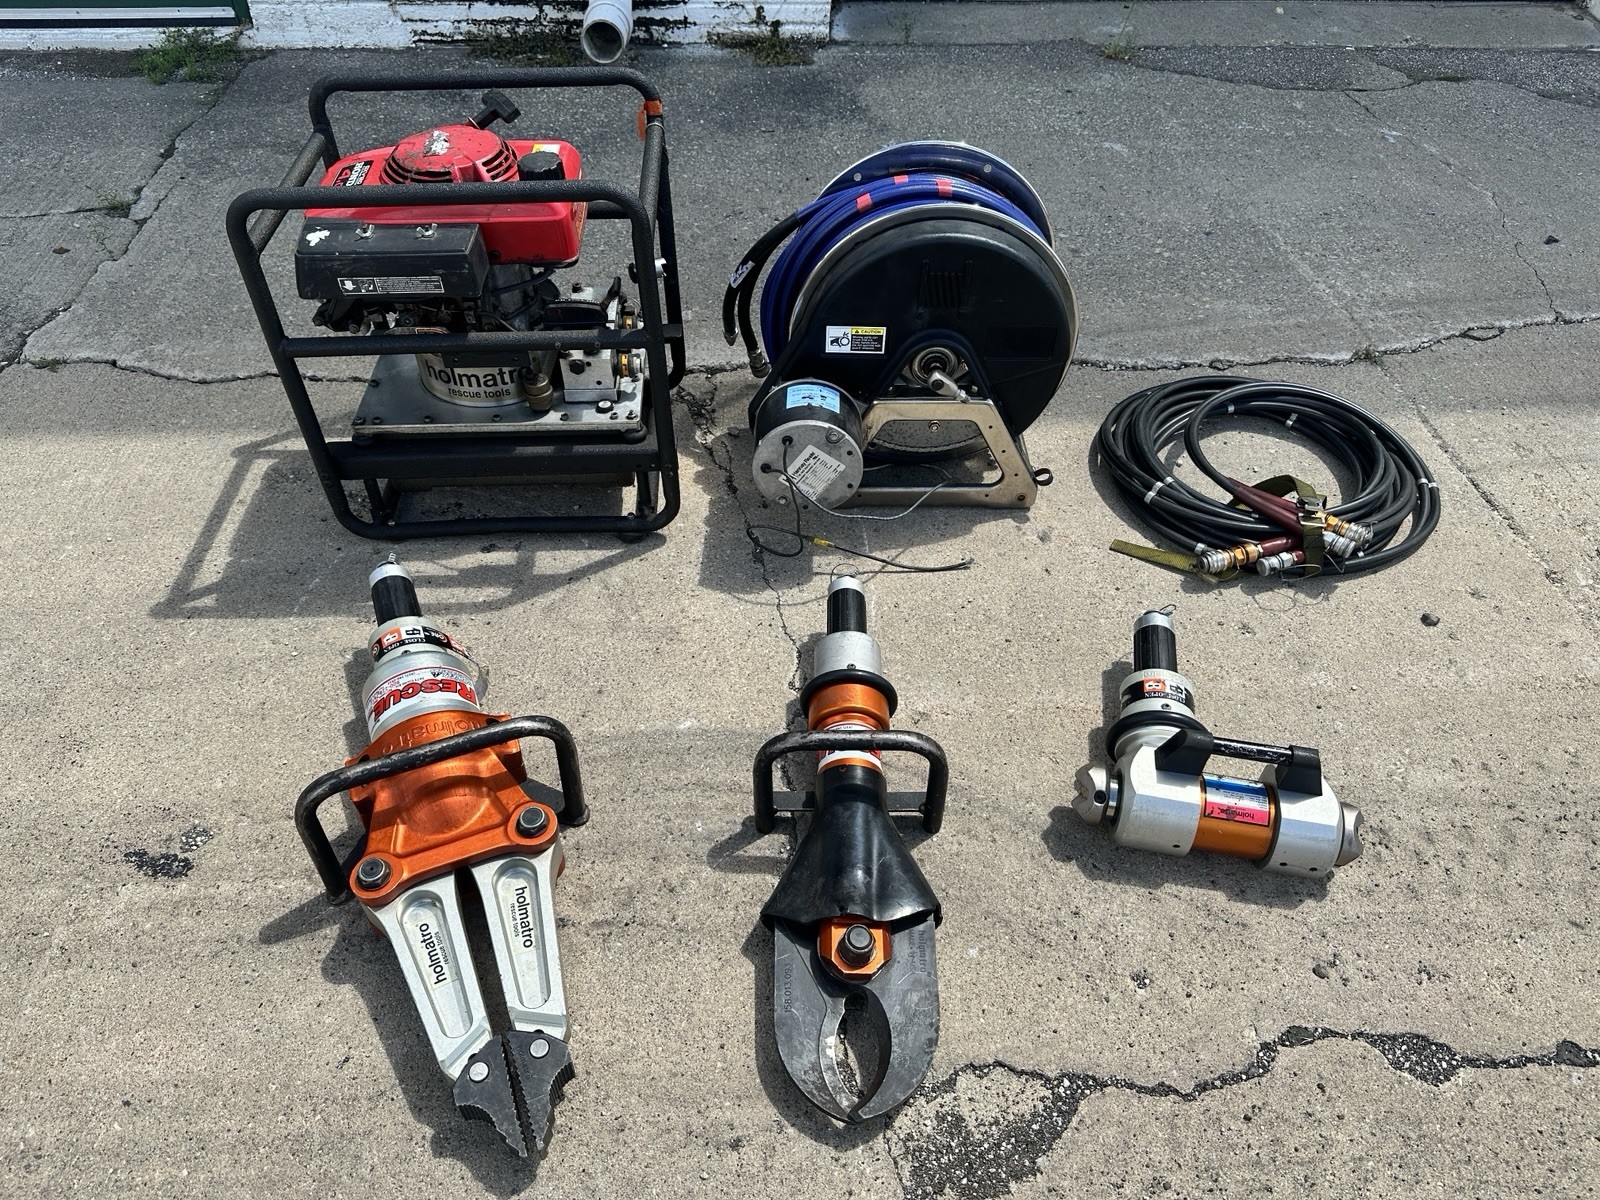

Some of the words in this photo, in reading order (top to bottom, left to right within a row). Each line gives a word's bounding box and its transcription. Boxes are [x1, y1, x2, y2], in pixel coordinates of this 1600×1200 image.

[345, 161, 365, 187] HOND
[448, 387, 482, 399] rescue
[484, 387, 511, 399] tools
[372, 678, 478, 722] RESCUE
[510, 902, 519, 923] rescue
[515, 885, 534, 949] holmatro
[419, 922, 448, 985] holmatro
[438, 946, 450, 965] rescue
